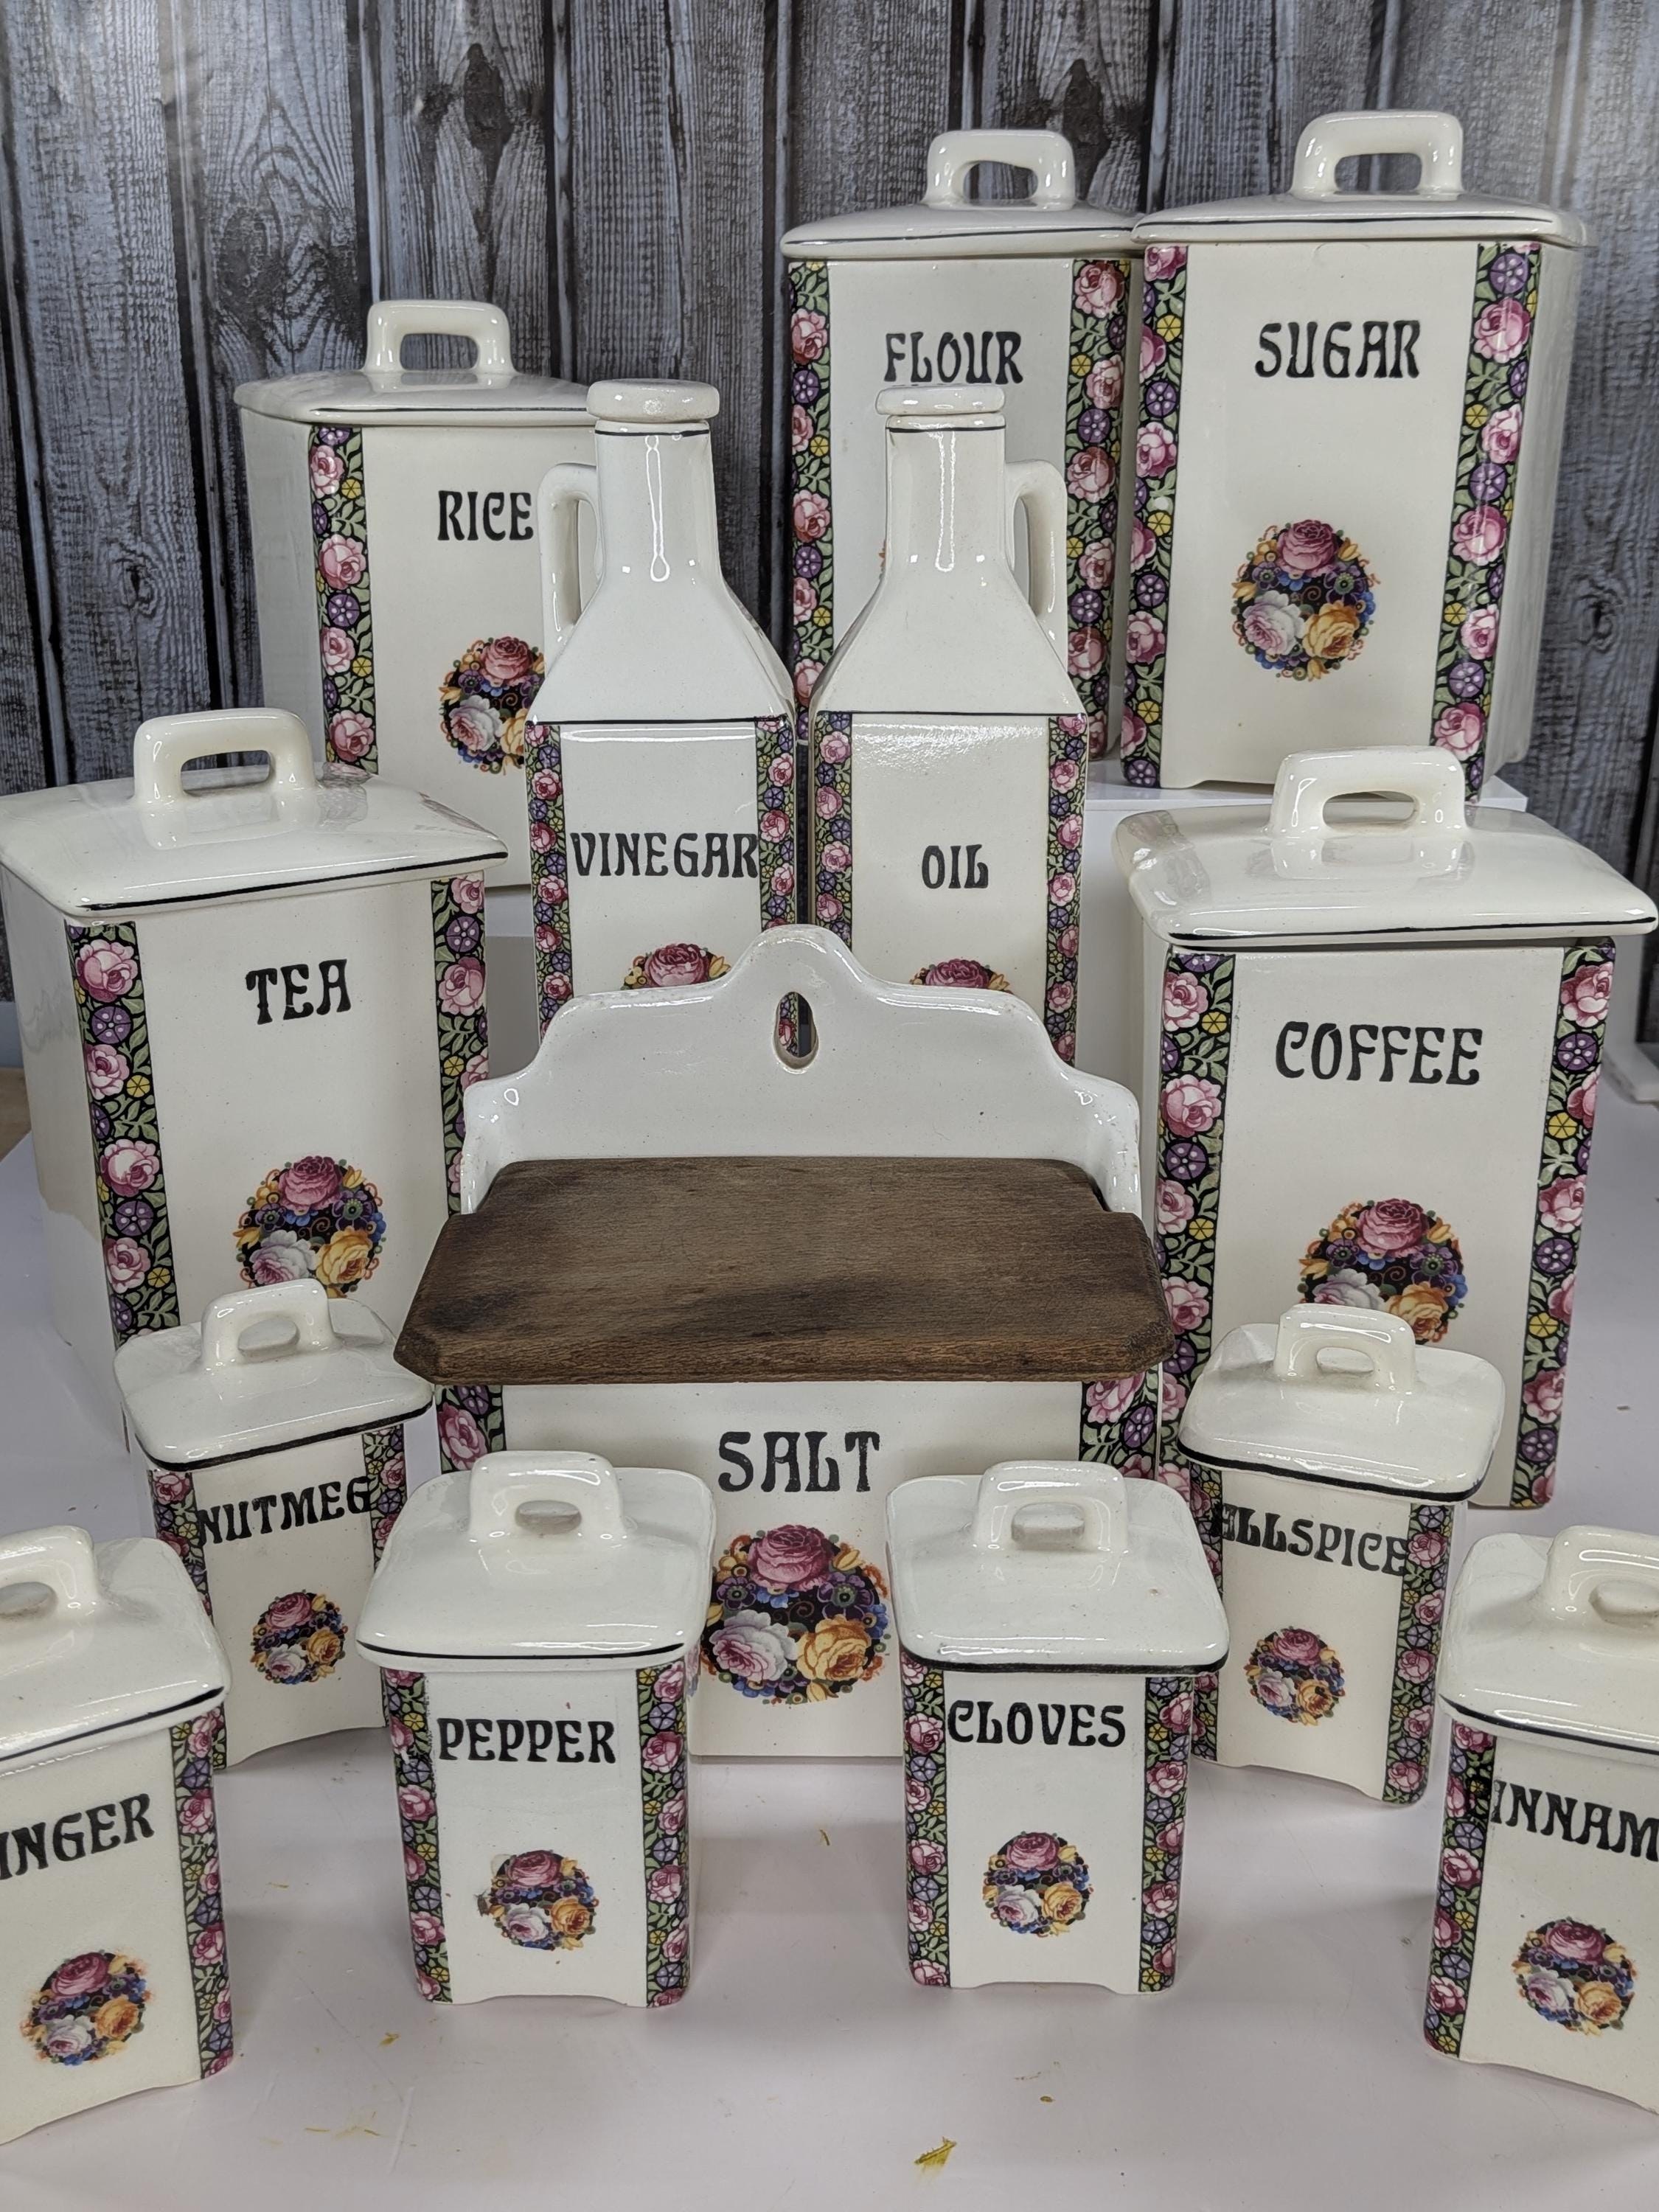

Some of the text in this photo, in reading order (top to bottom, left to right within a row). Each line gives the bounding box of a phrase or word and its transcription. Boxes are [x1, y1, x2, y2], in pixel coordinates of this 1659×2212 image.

[884, 331, 1023, 384] FLOUR
[1255, 320, 1420, 378] SUGAR
[438, 490, 534, 541] RICE
[570, 832, 759, 878] VINEGAR
[922, 844, 988, 889] OIL
[246, 959, 352, 1025] TEA
[1276, 1021, 1483, 1085] COFFEE
[718, 1431, 880, 1493] SALT
[198, 1476, 373, 1546] NUTMEG
[437, 1718, 616, 1764] PEPPER
[947, 1700, 1125, 1747] CLOVES
[1490, 1779, 1659, 1862] INNAM
